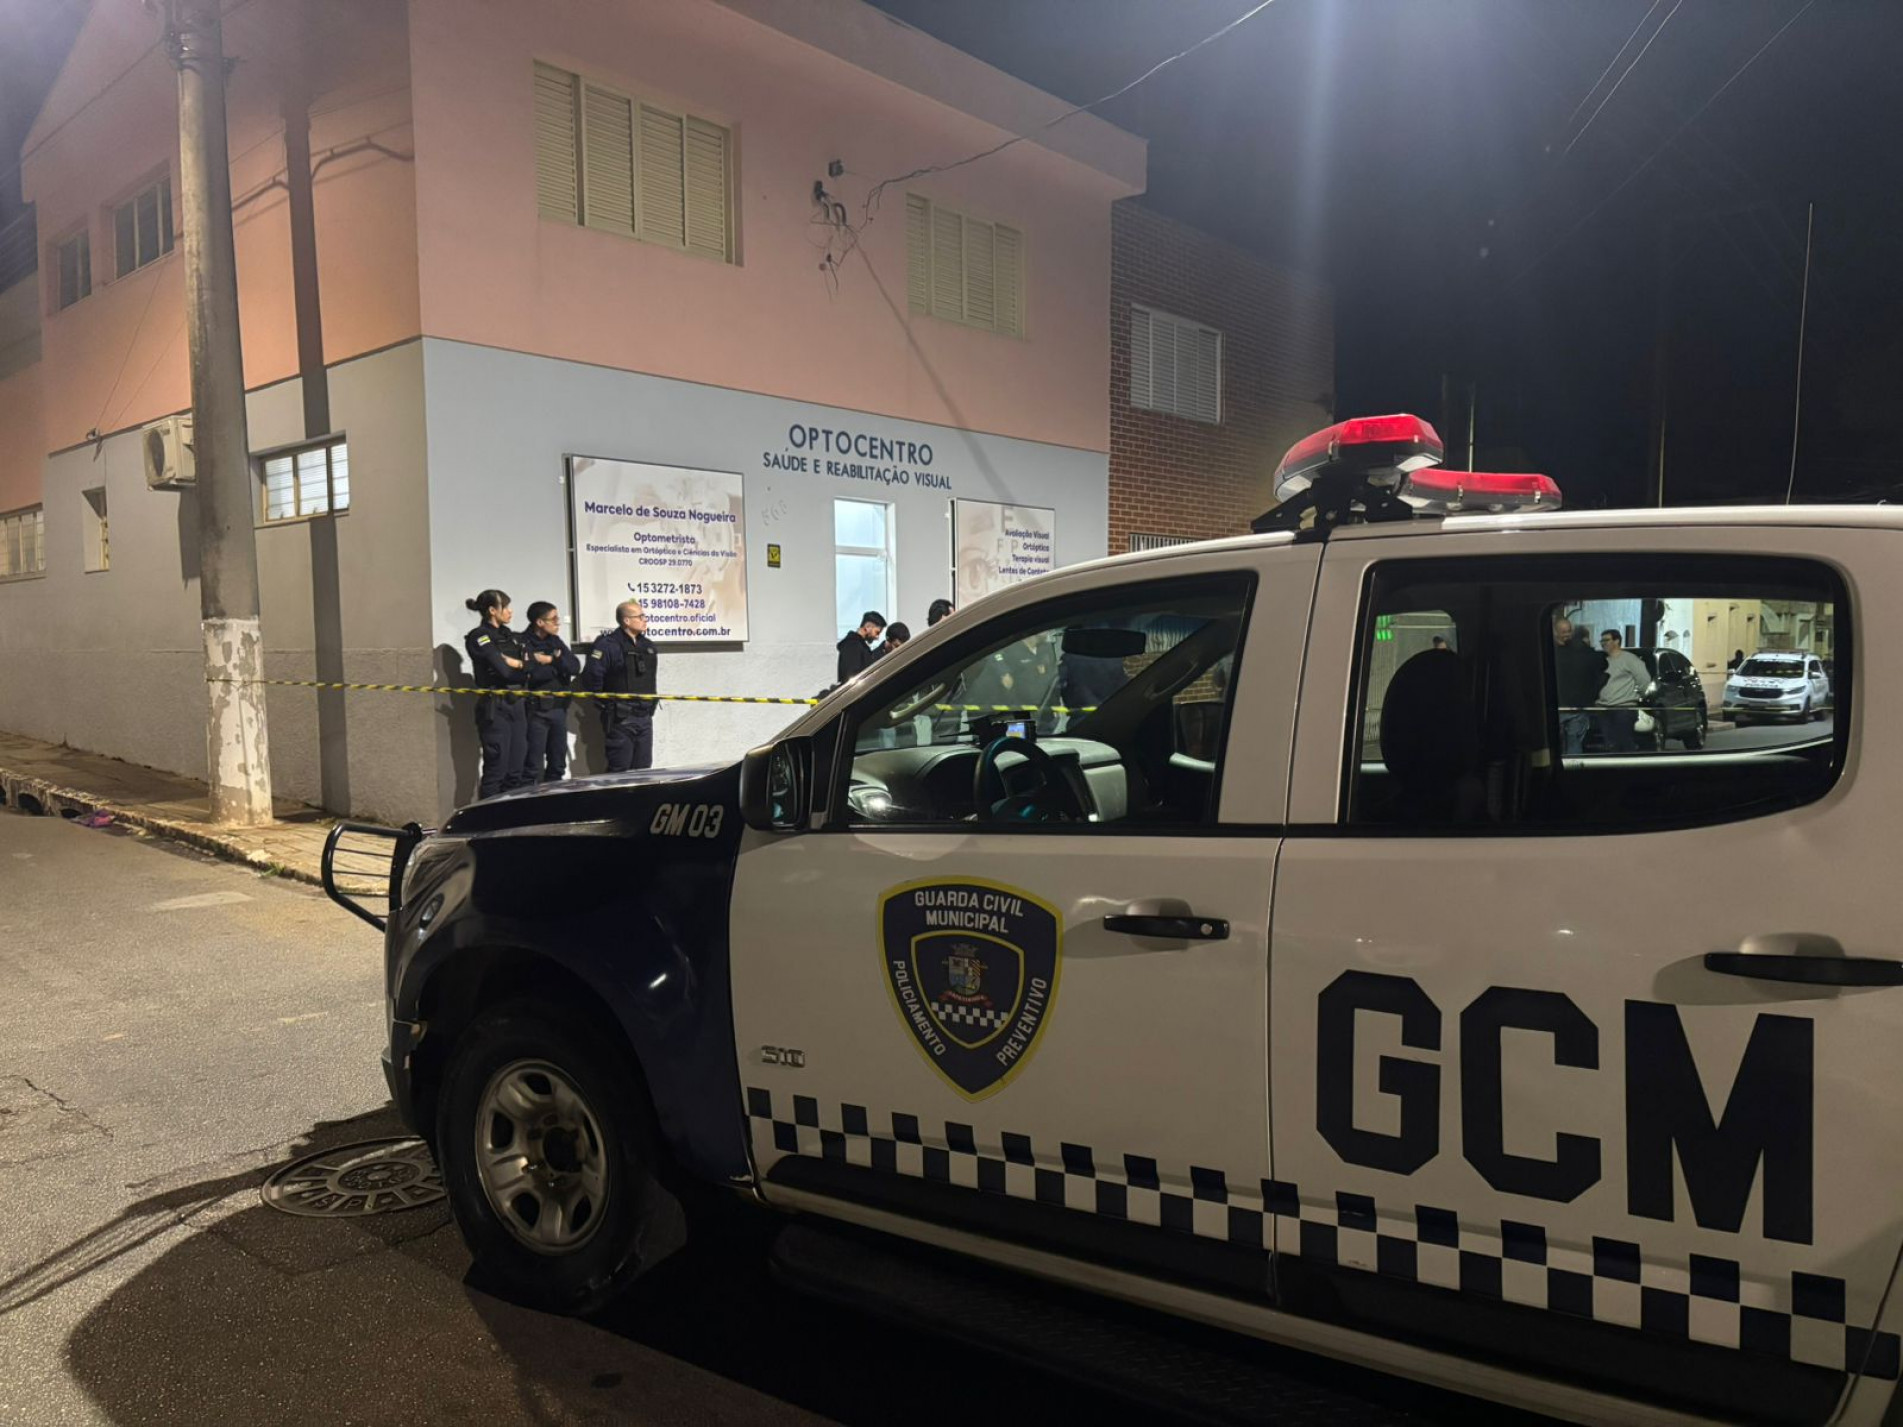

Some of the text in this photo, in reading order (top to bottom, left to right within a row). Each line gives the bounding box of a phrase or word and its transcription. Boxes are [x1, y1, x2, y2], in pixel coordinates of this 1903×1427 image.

[789, 424, 933, 466] OPTOCENTRO
[763, 447, 952, 490] SAÚDE E REABILITAÇÃO VISUAL
[584, 501, 736, 524] Marcelo de Souza Nogueira
[633, 532, 696, 544] Optometrista
[1033, 531, 1050, 540] Visual
[586, 543, 630, 554] Especialista
[631, 546, 642, 554] em
[683, 547, 710, 557] Ciências
[998, 566, 1018, 574] Lentes
[1019, 566, 1026, 574] de
[637, 582, 703, 594] 15 3272-1873
[639, 599, 706, 609] 15 98108-7428
[649, 803, 724, 838] GM 03
[915, 890, 1024, 917] GUARDA CIVIL
[925, 910, 1009, 934] MUNICIPAL
[893, 960, 947, 1056] POLICIAMENTO
[995, 977, 1048, 1067] PREVENTIVO
[1316, 969, 1814, 1245] GCM
